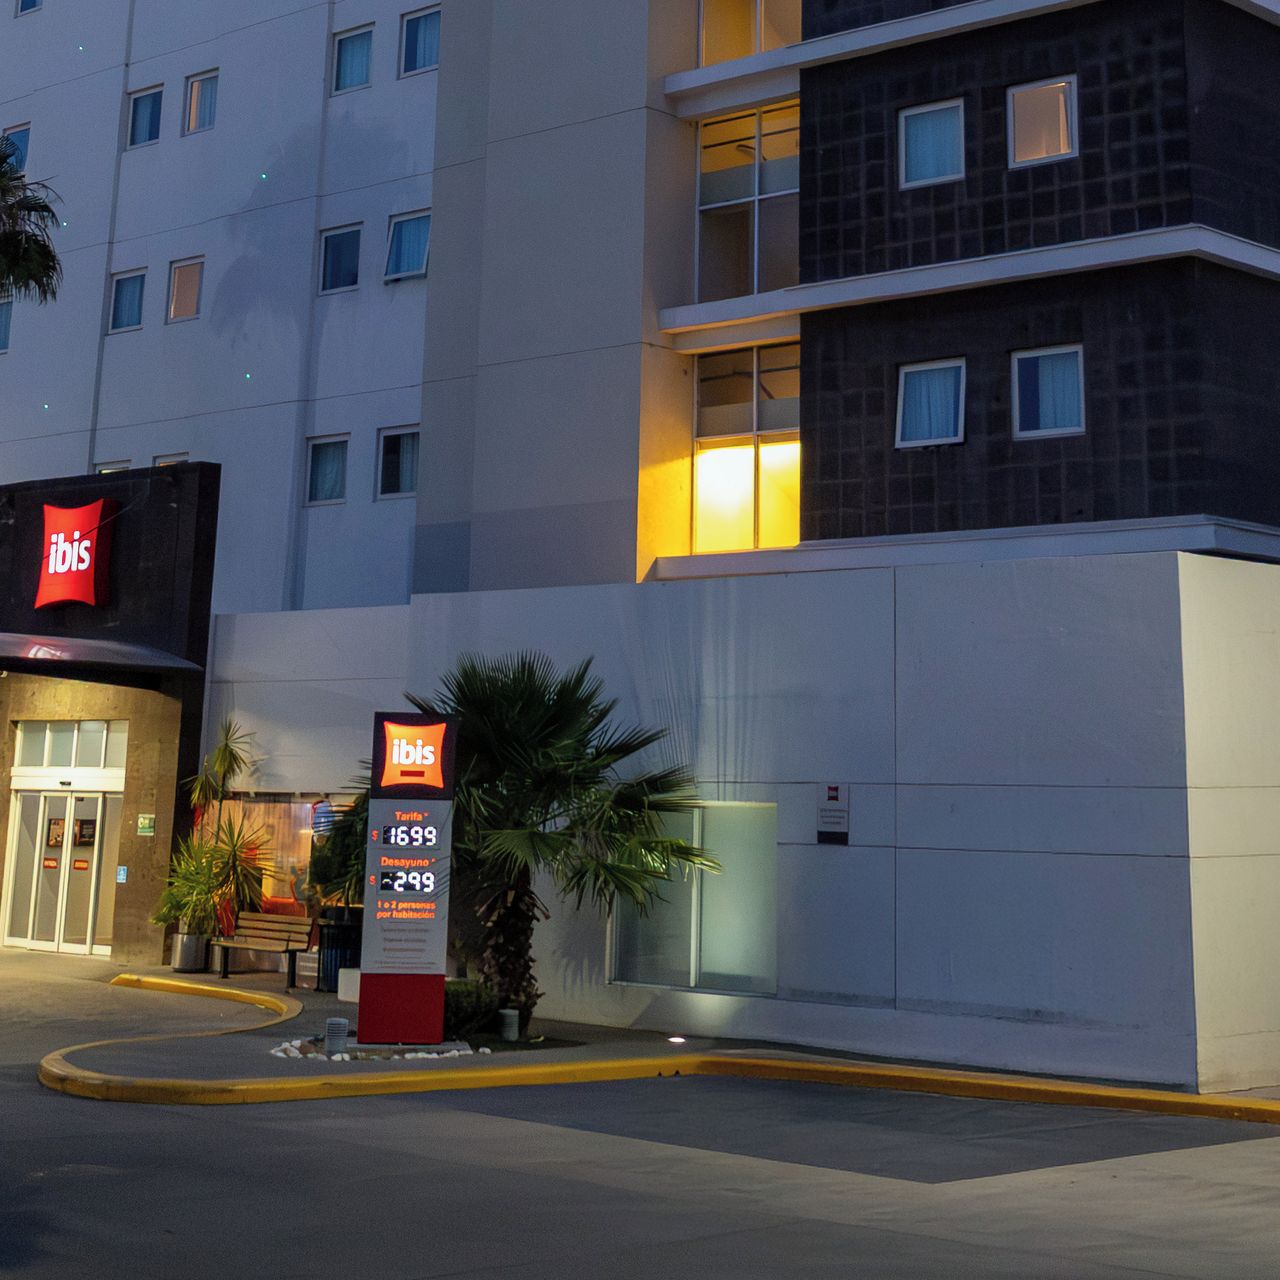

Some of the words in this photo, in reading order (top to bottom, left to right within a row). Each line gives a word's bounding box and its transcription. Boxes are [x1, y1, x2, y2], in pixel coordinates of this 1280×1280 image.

[48, 530, 91, 574] ibis
[392, 738, 435, 765] ibis
[395, 810, 423, 821] Tarifa
[390, 826, 437, 846] 1699
[381, 856, 429, 868] Desayuno
